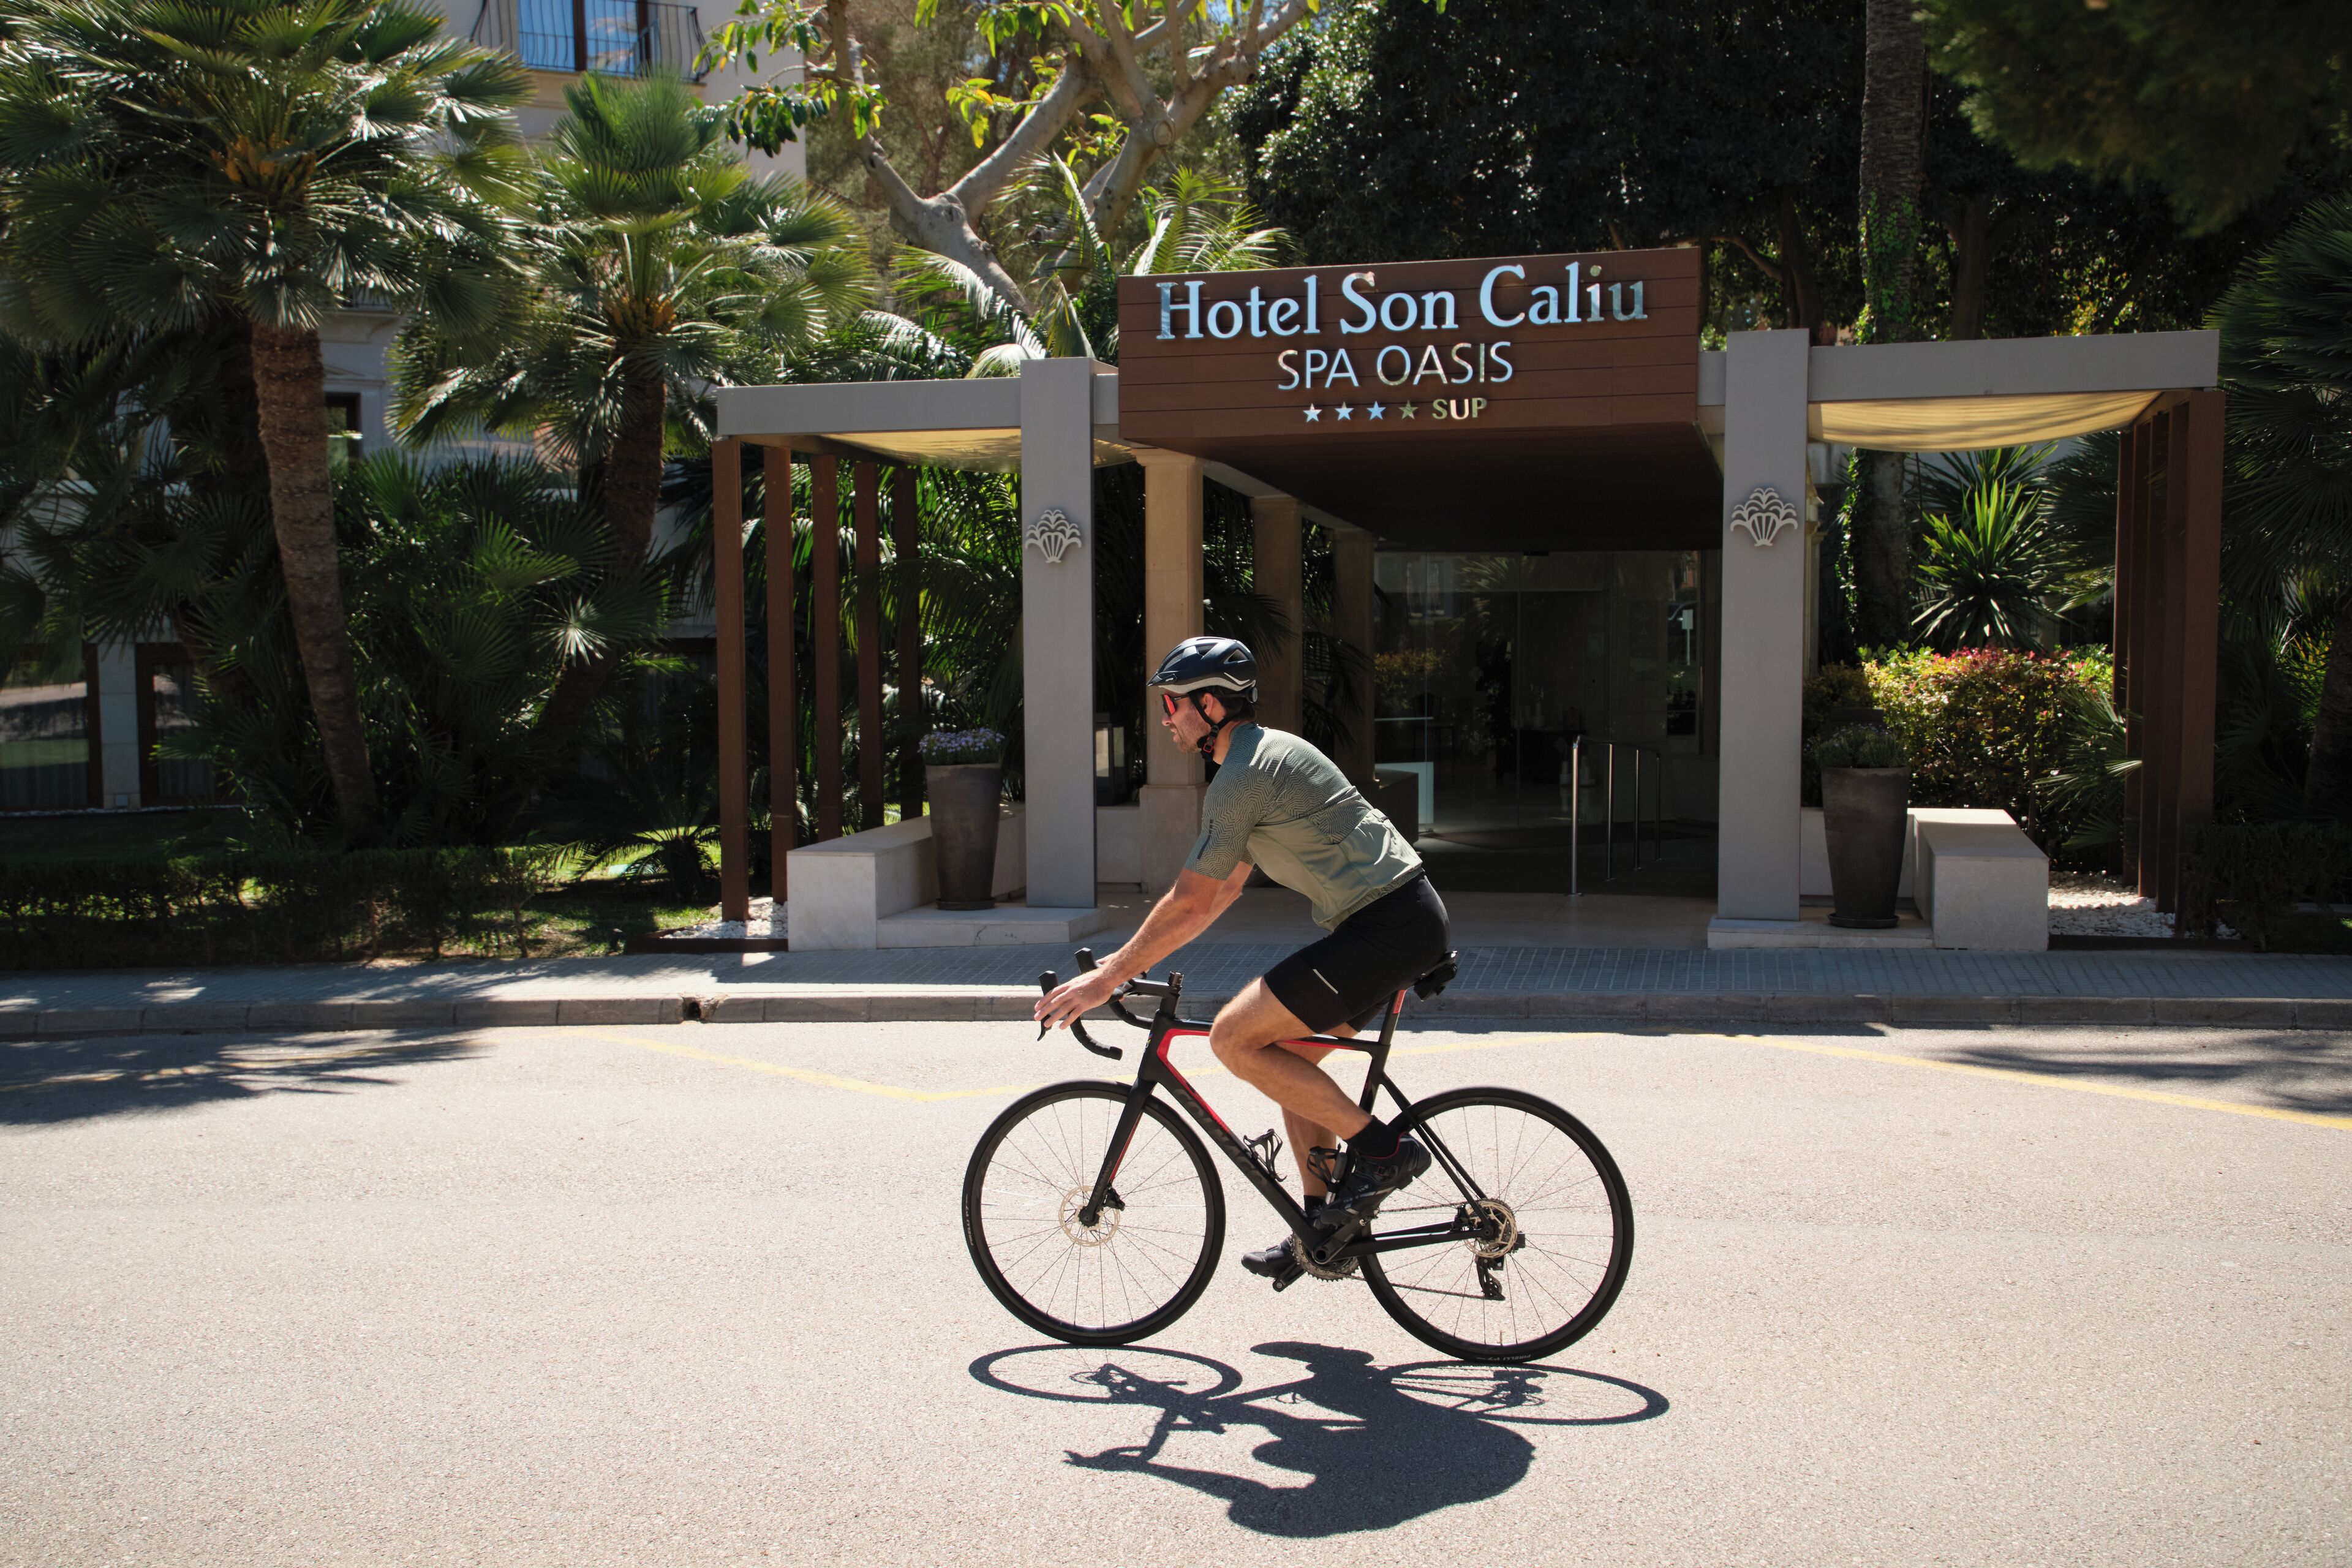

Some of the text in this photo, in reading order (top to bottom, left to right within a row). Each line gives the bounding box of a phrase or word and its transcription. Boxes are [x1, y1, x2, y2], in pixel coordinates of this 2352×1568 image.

[1156, 261, 1648, 339] Hotel Son Caliu
[1278, 341, 1513, 390] SPA OASIS
[1432, 398, 1487, 420] SUP
